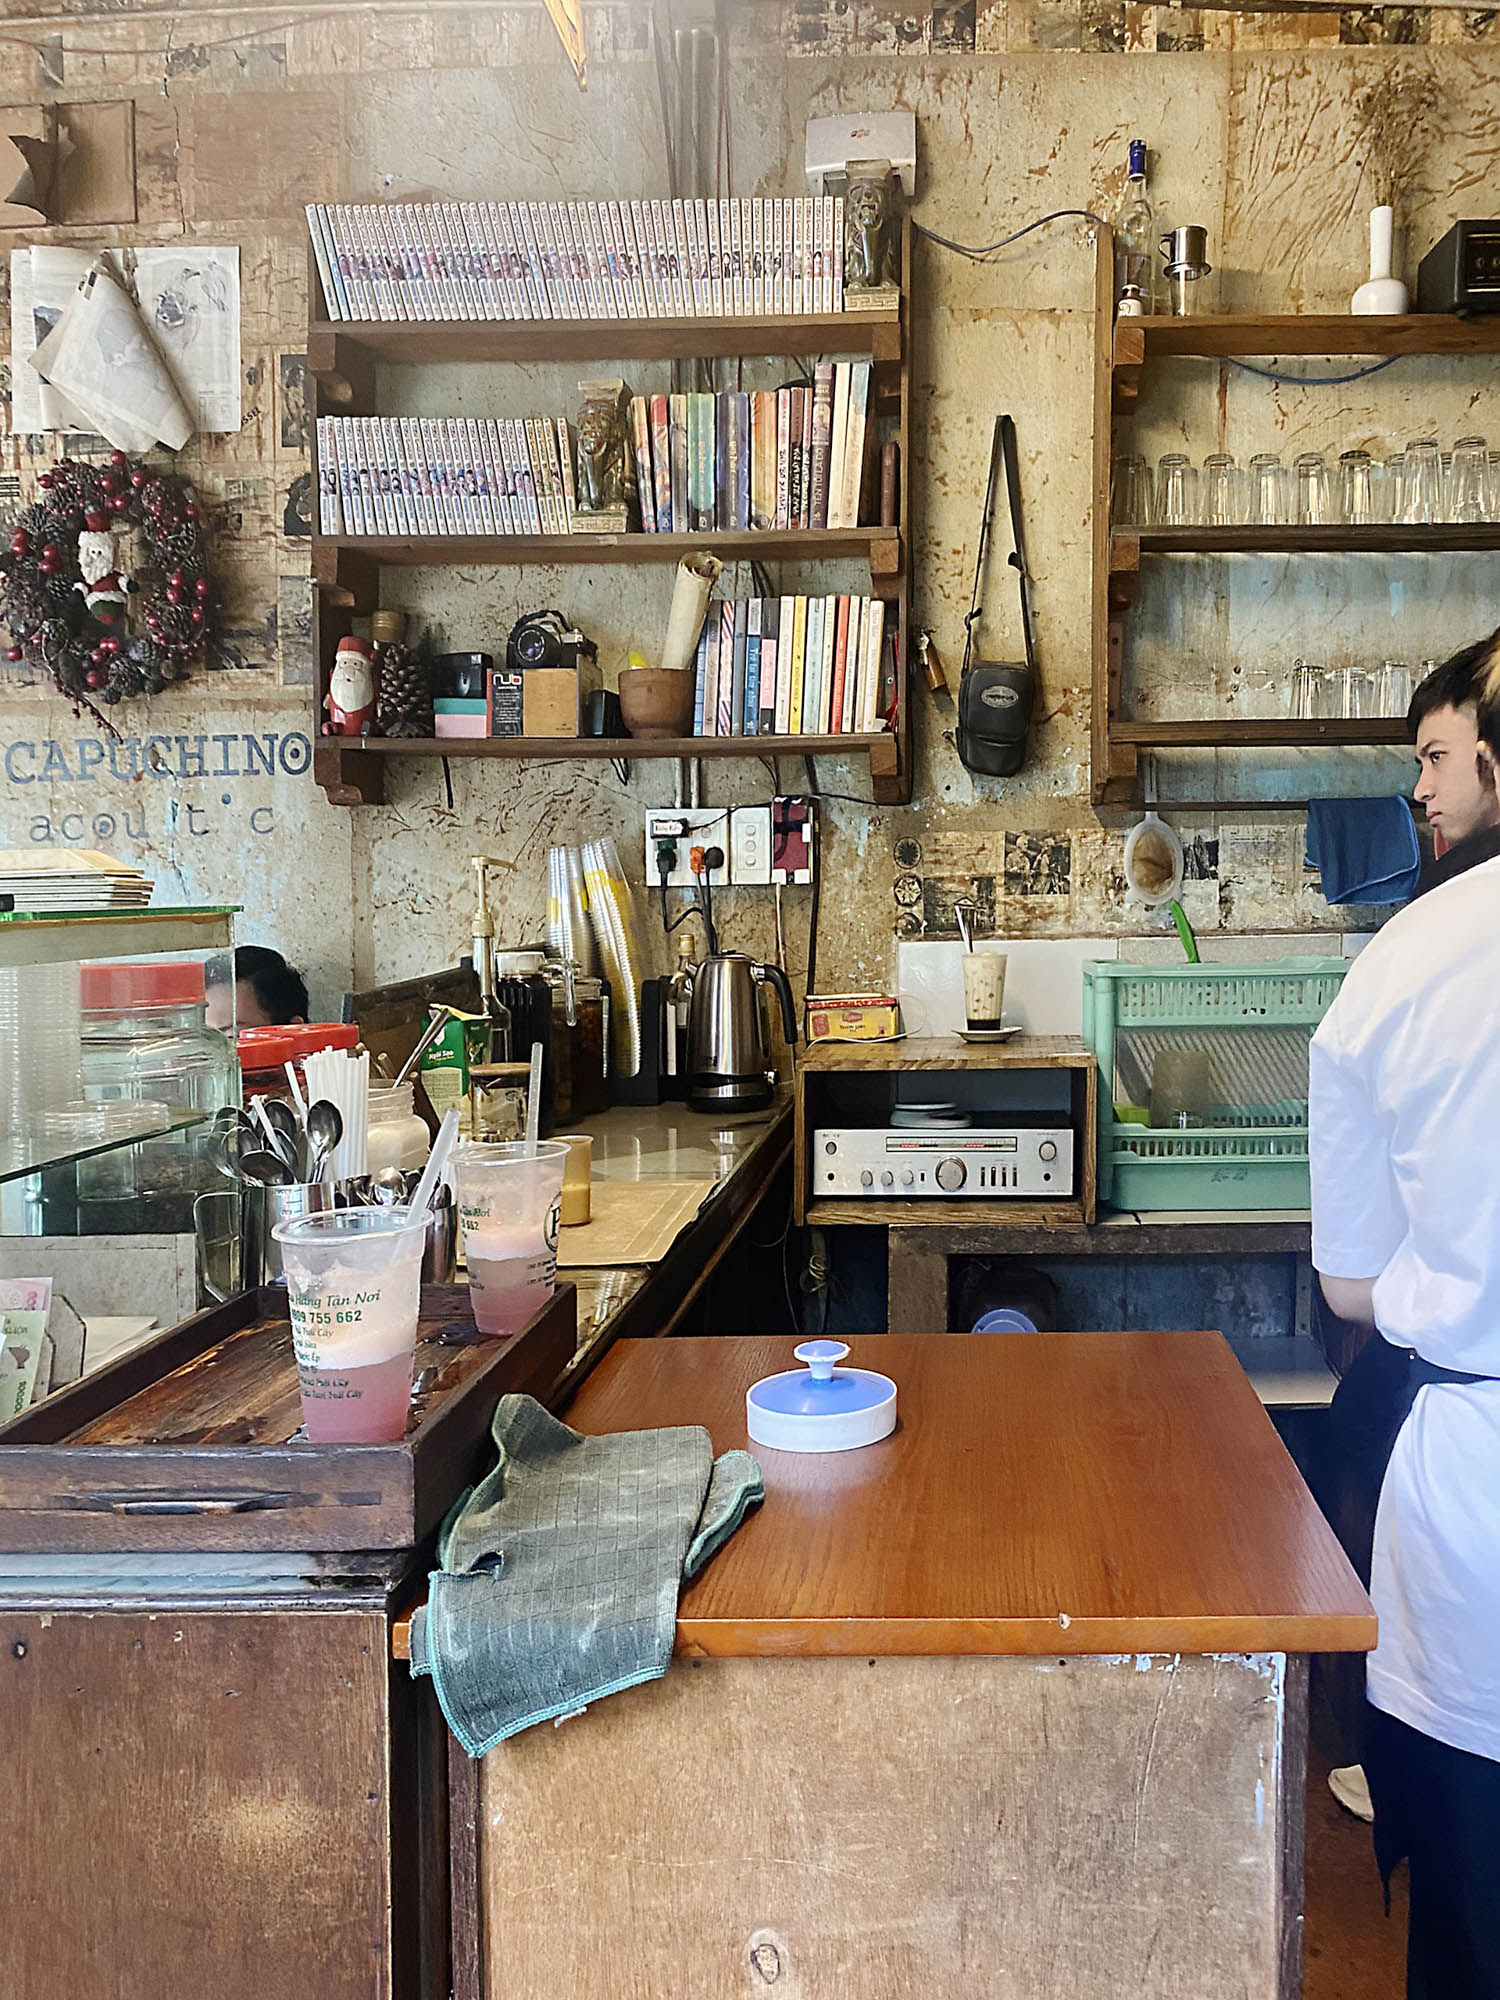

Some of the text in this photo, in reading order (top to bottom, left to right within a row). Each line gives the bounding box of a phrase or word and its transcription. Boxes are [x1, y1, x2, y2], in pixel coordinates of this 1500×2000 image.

[4, 731, 314, 784] CAPUCHINO
[354, 1289, 381, 1304] Nơi
[309, 1312, 332, 1324] 755
[336, 1310, 362, 1323] 662
